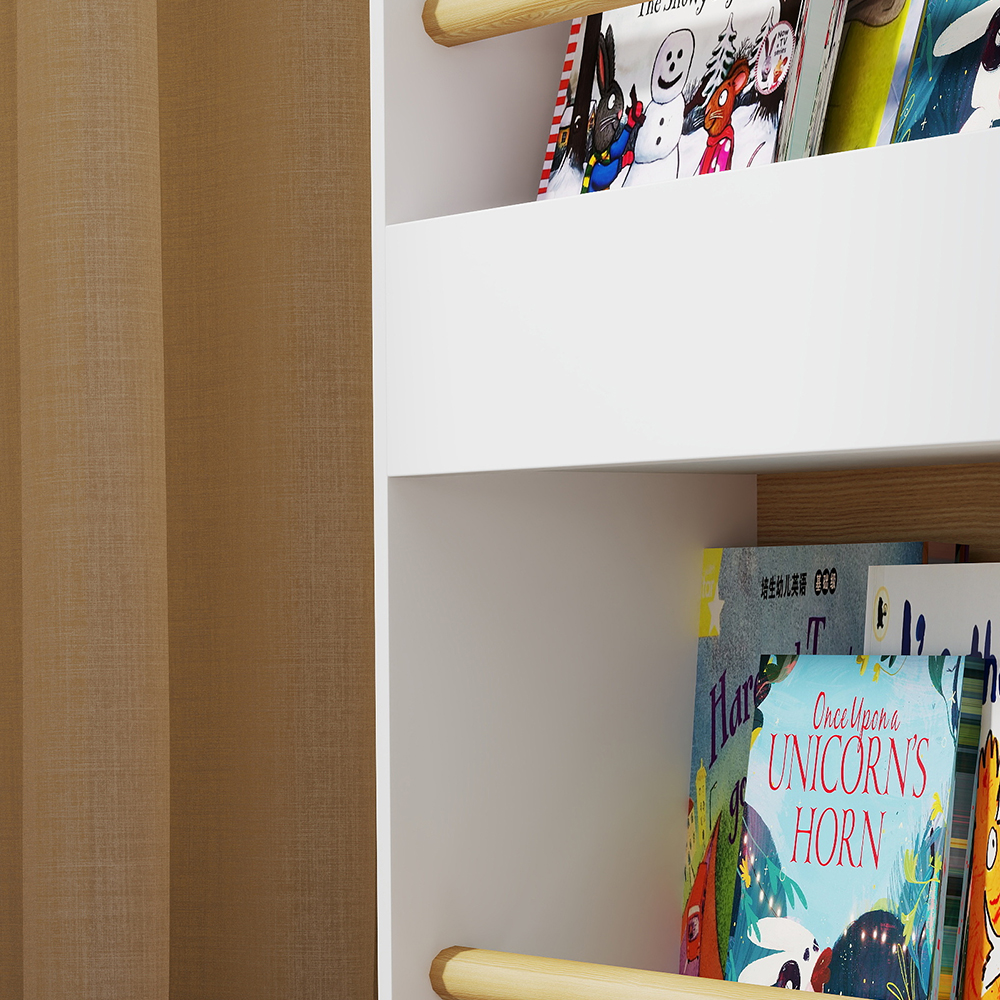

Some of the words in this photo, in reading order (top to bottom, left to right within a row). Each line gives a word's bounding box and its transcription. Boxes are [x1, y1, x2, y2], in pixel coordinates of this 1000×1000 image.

[780, 37, 788, 47] TV
[760, 573, 807, 600] 培生幼儿英语
[813, 691, 849, 730] Once
[850, 696, 889, 753] Upon
[890, 709, 901, 731] a
[768, 733, 930, 798] UNICORN'S
[790, 806, 887, 870] HORN
